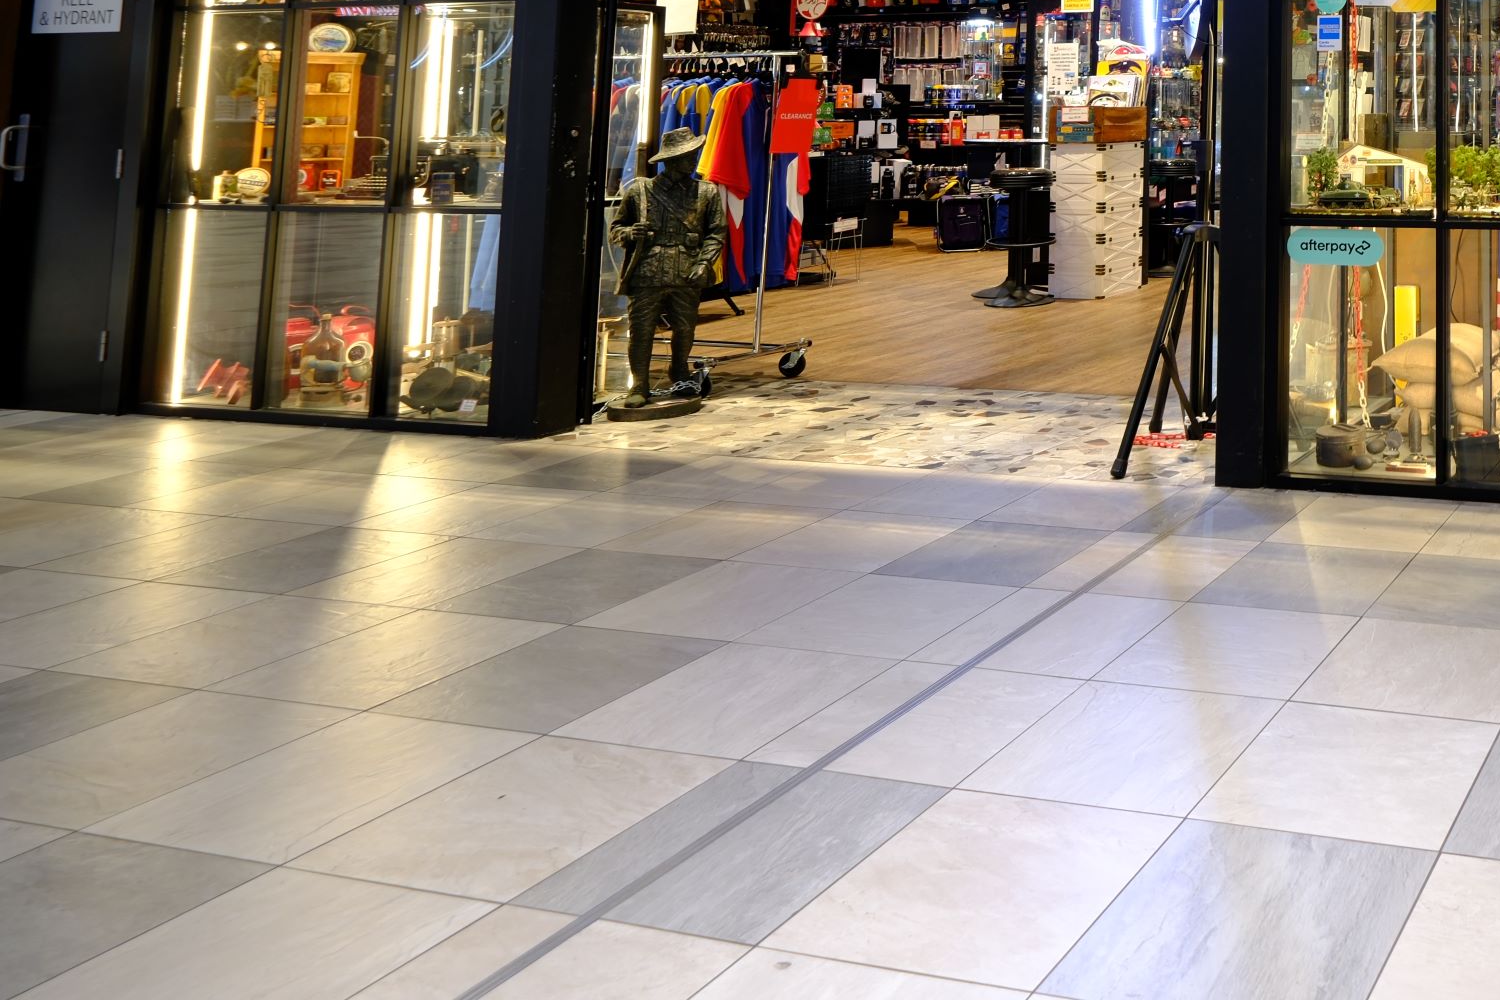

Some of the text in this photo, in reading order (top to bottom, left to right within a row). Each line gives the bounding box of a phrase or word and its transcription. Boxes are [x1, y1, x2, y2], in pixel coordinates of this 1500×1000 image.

[39, 9, 115, 26] & HYDRANT
[780, 112, 813, 120] CLEARANCE
[1299, 238, 1356, 255] afterpay
